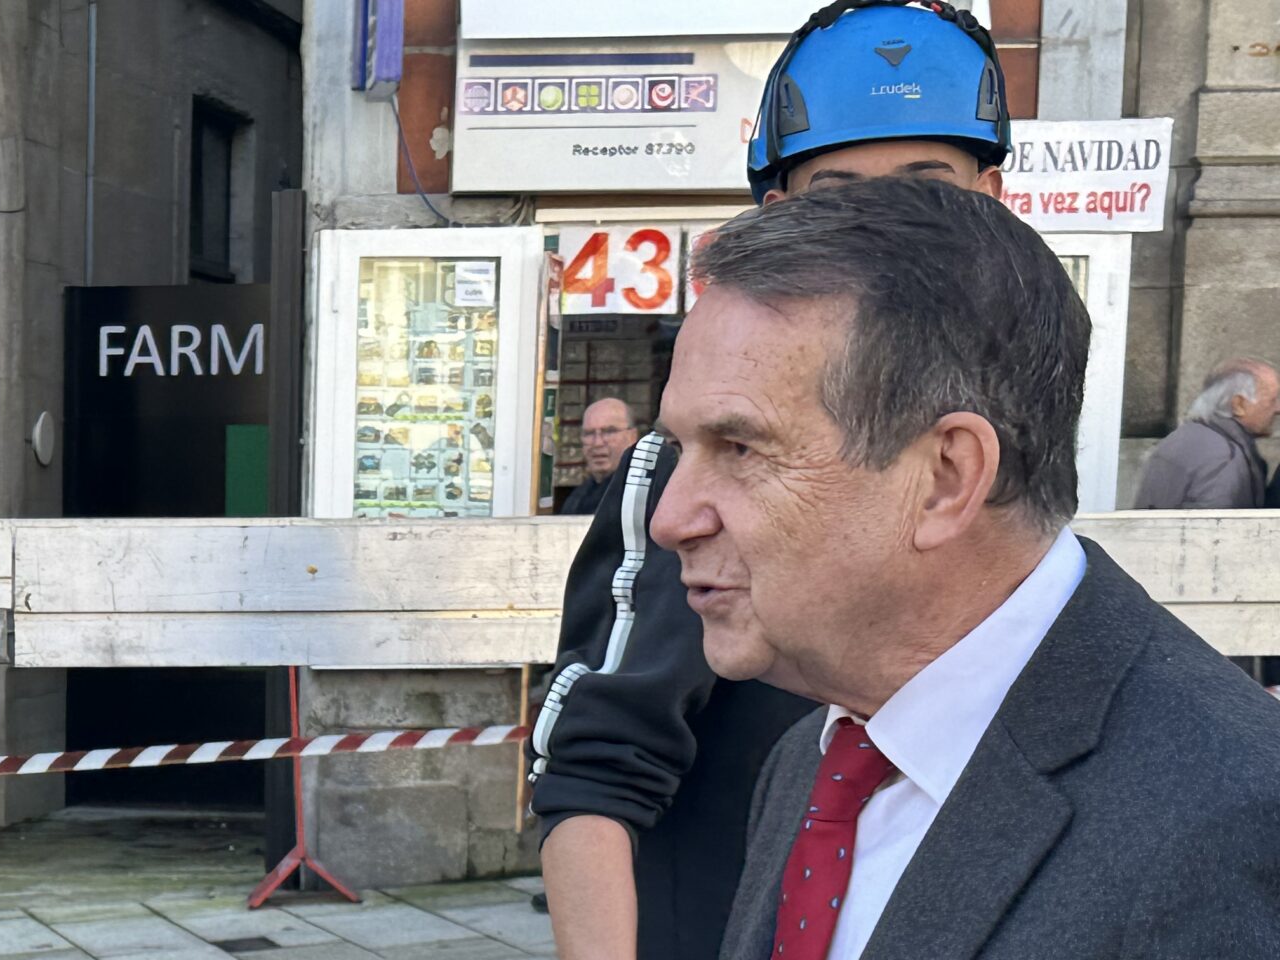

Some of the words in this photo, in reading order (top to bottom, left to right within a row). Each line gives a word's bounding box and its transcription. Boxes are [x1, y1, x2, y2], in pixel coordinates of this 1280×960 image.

[572, 143, 638, 157] Receptor
[1041, 139, 1161, 172] NAVIDAD
[1039, 192, 1081, 214] vez
[1084, 182, 1151, 220] aquí?
[561, 228, 673, 310] 43
[98, 323, 264, 377] FARM
